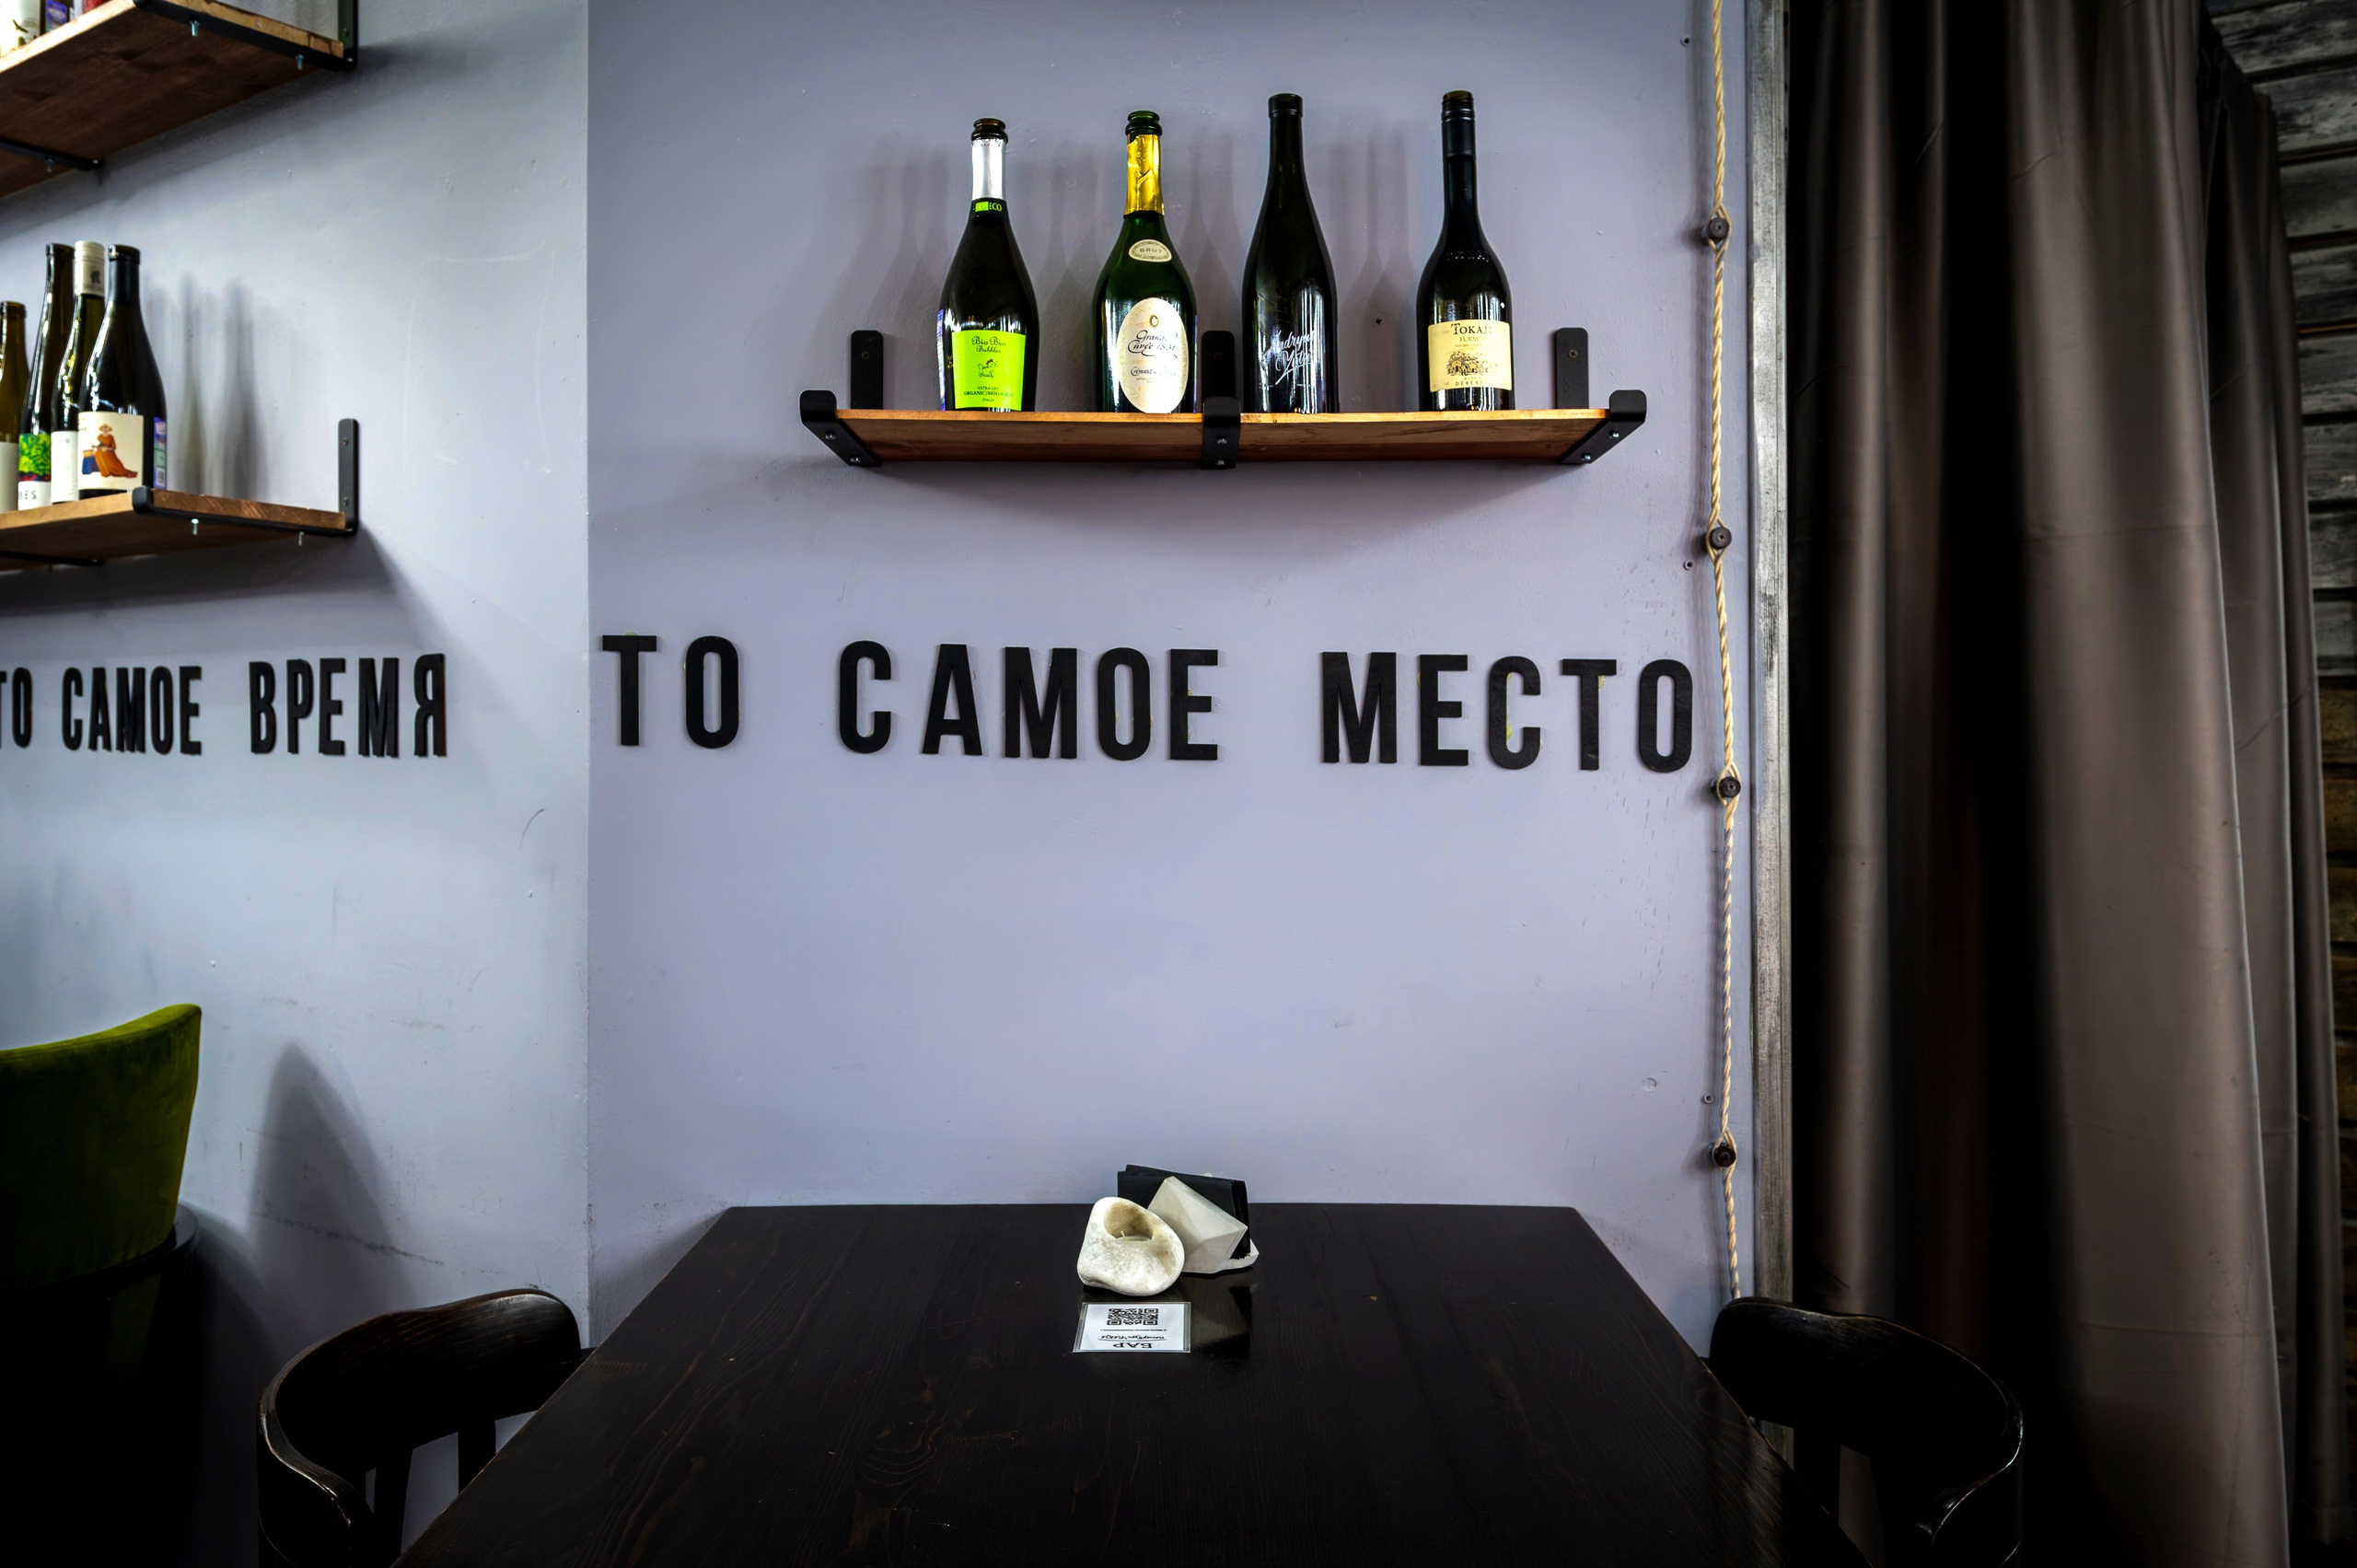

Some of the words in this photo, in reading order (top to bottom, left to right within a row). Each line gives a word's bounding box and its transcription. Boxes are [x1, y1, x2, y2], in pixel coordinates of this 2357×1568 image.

[989, 202, 1003, 212] ECO
[971, 336, 988, 344] Bio
[990, 336, 1005, 345] Bio
[62, 665, 203, 756] САМОЕ
[249, 653, 447, 759] ВРЕМЯ
[601, 634, 741, 749] ТО
[838, 640, 1219, 761] САМОЕ
[1321, 651, 1693, 773] МЕСТО
